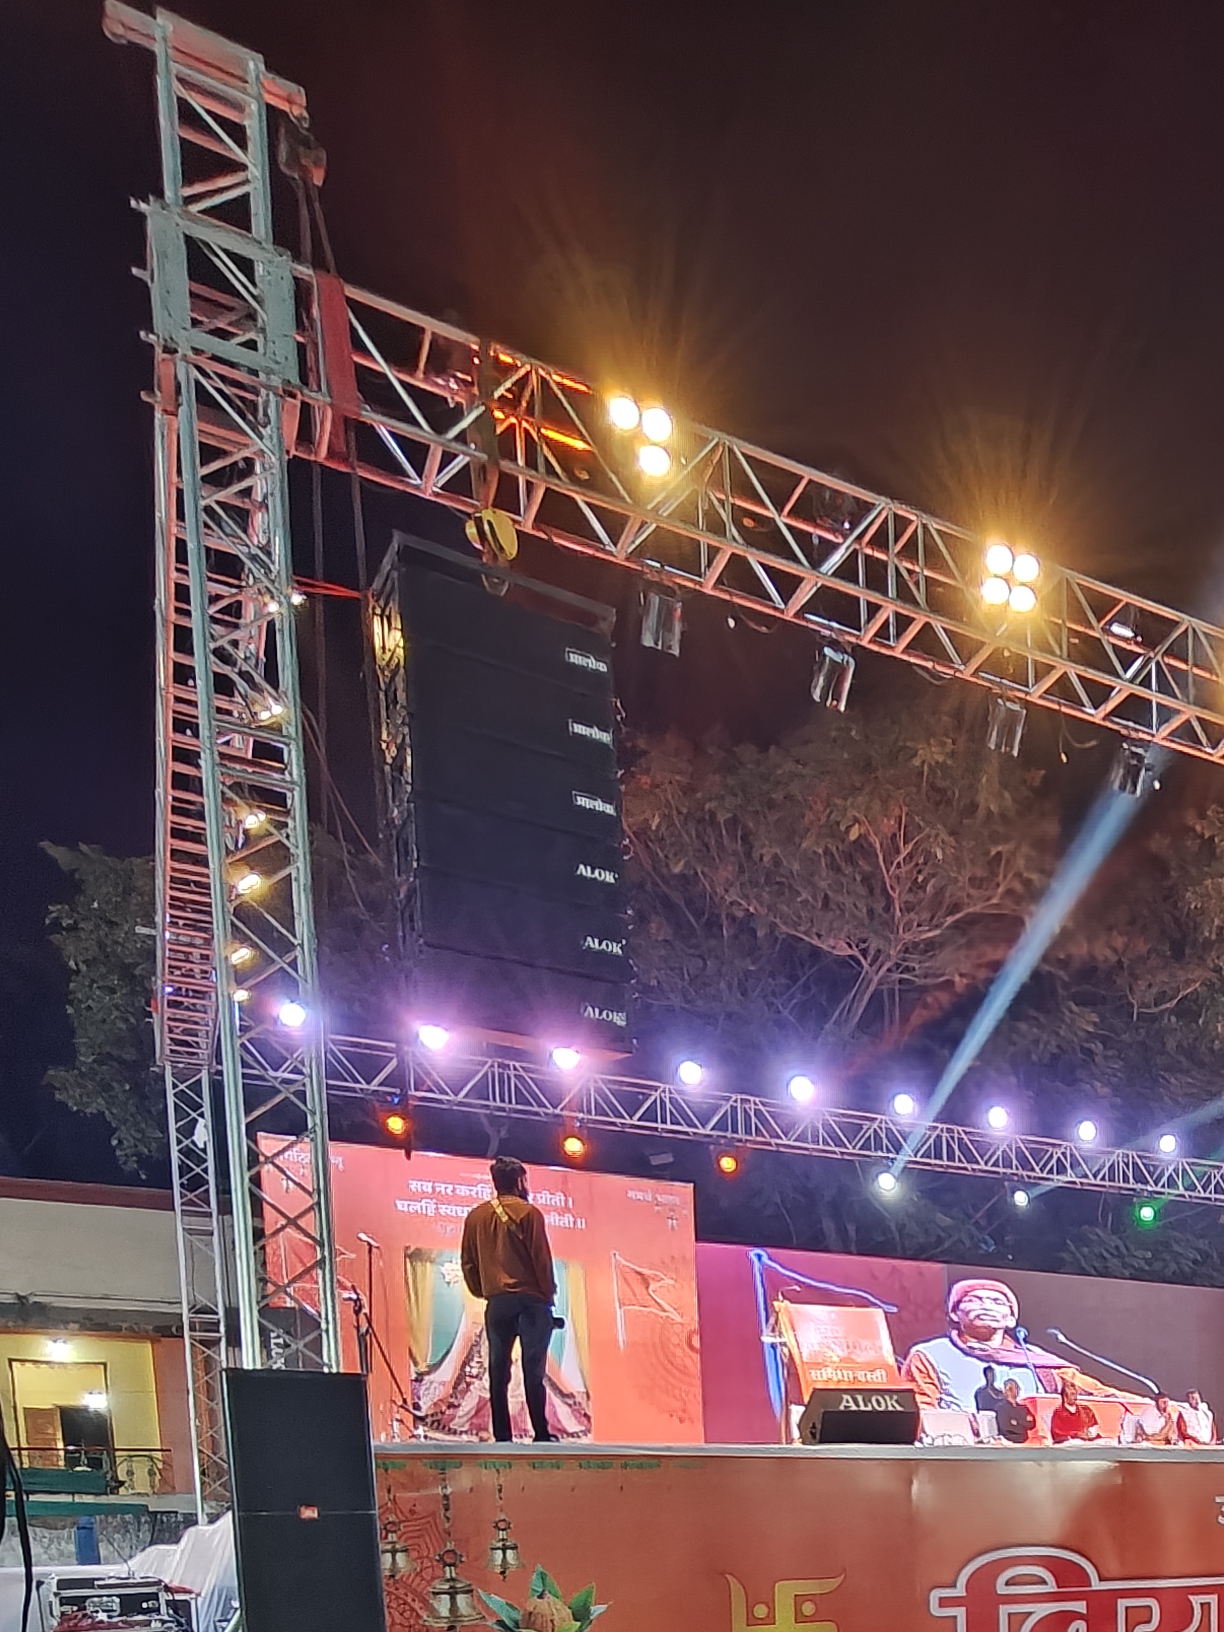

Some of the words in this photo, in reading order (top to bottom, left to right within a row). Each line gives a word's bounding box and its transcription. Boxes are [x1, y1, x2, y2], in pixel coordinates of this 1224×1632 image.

[576, 863, 616, 884] ALOK
[584, 936, 624, 956] ALOK
[838, 1393, 904, 1411] ALOK
